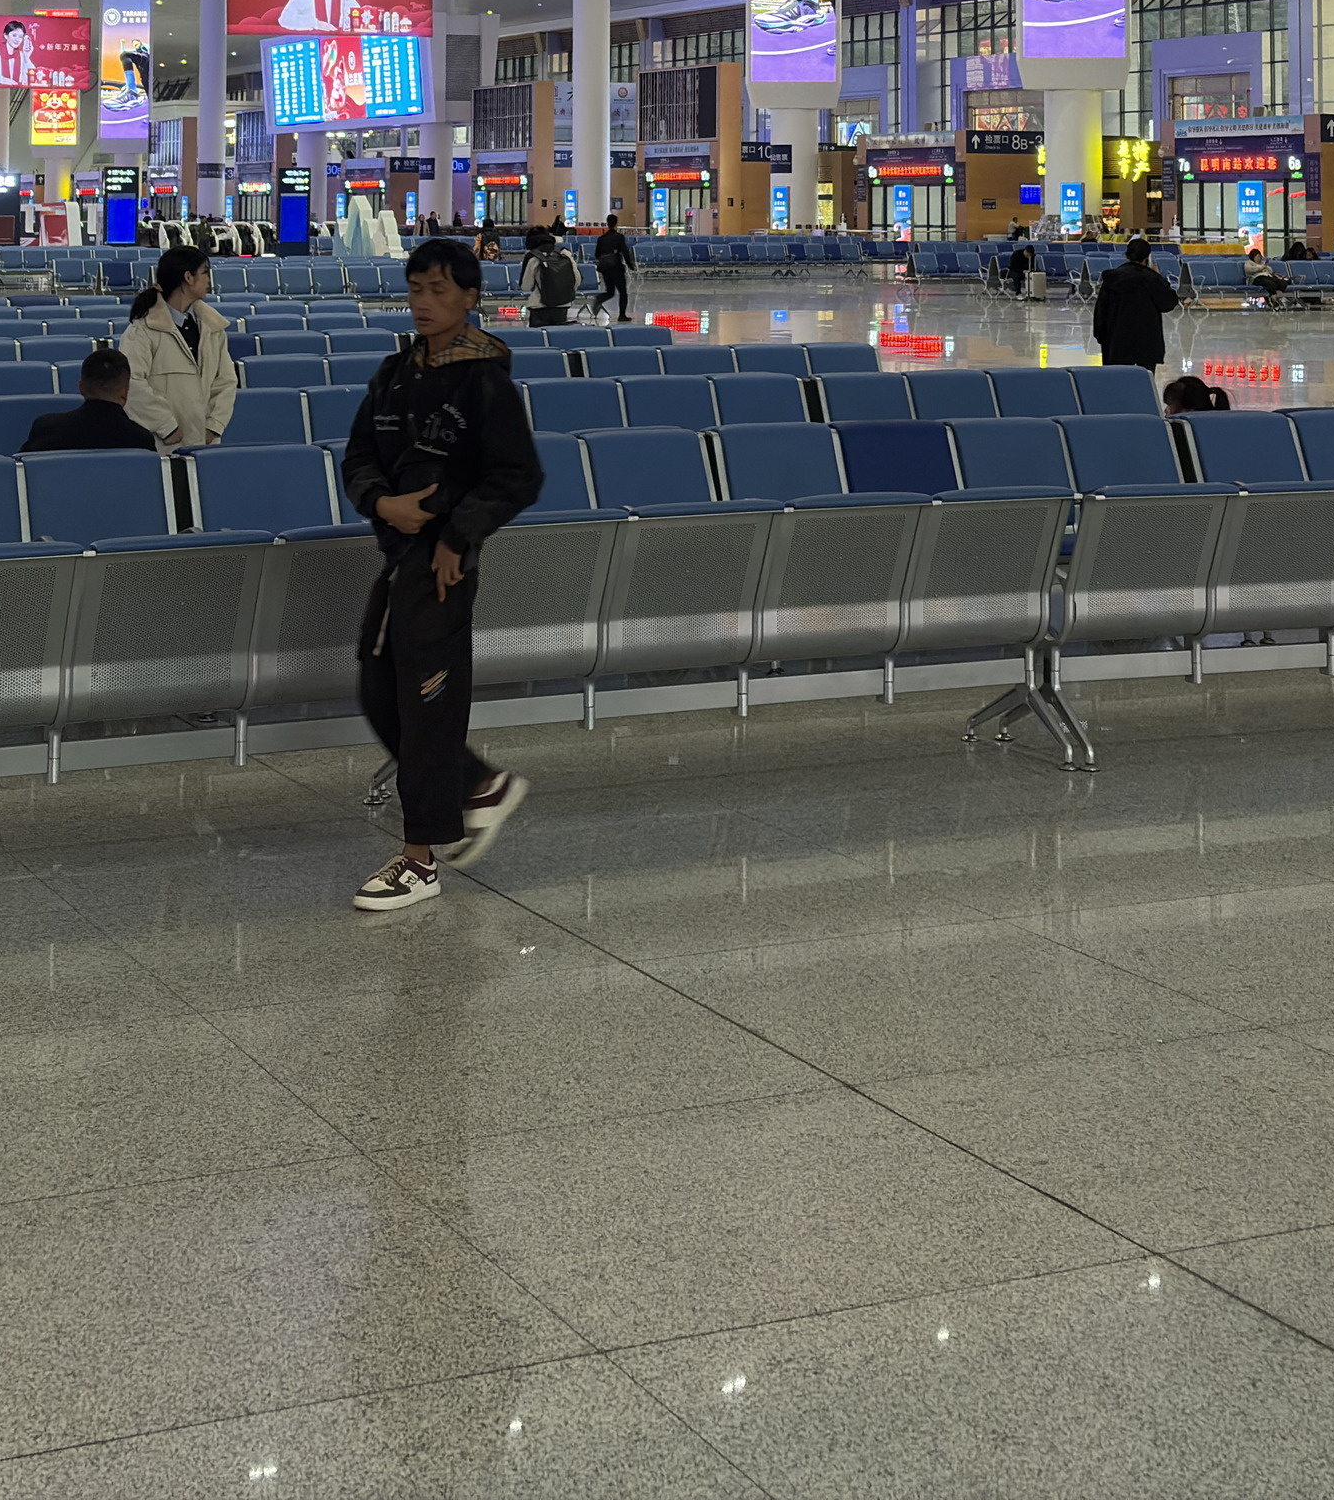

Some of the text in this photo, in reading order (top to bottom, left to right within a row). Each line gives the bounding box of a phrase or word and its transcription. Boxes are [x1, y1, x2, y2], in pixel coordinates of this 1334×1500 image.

[985, 135, 1009, 144] 检票口
[1178, 158, 1191, 172] 7B
[1200, 155, 1278, 172] 昆明南站欢迎您
[1288, 155, 1302, 171] 6B
